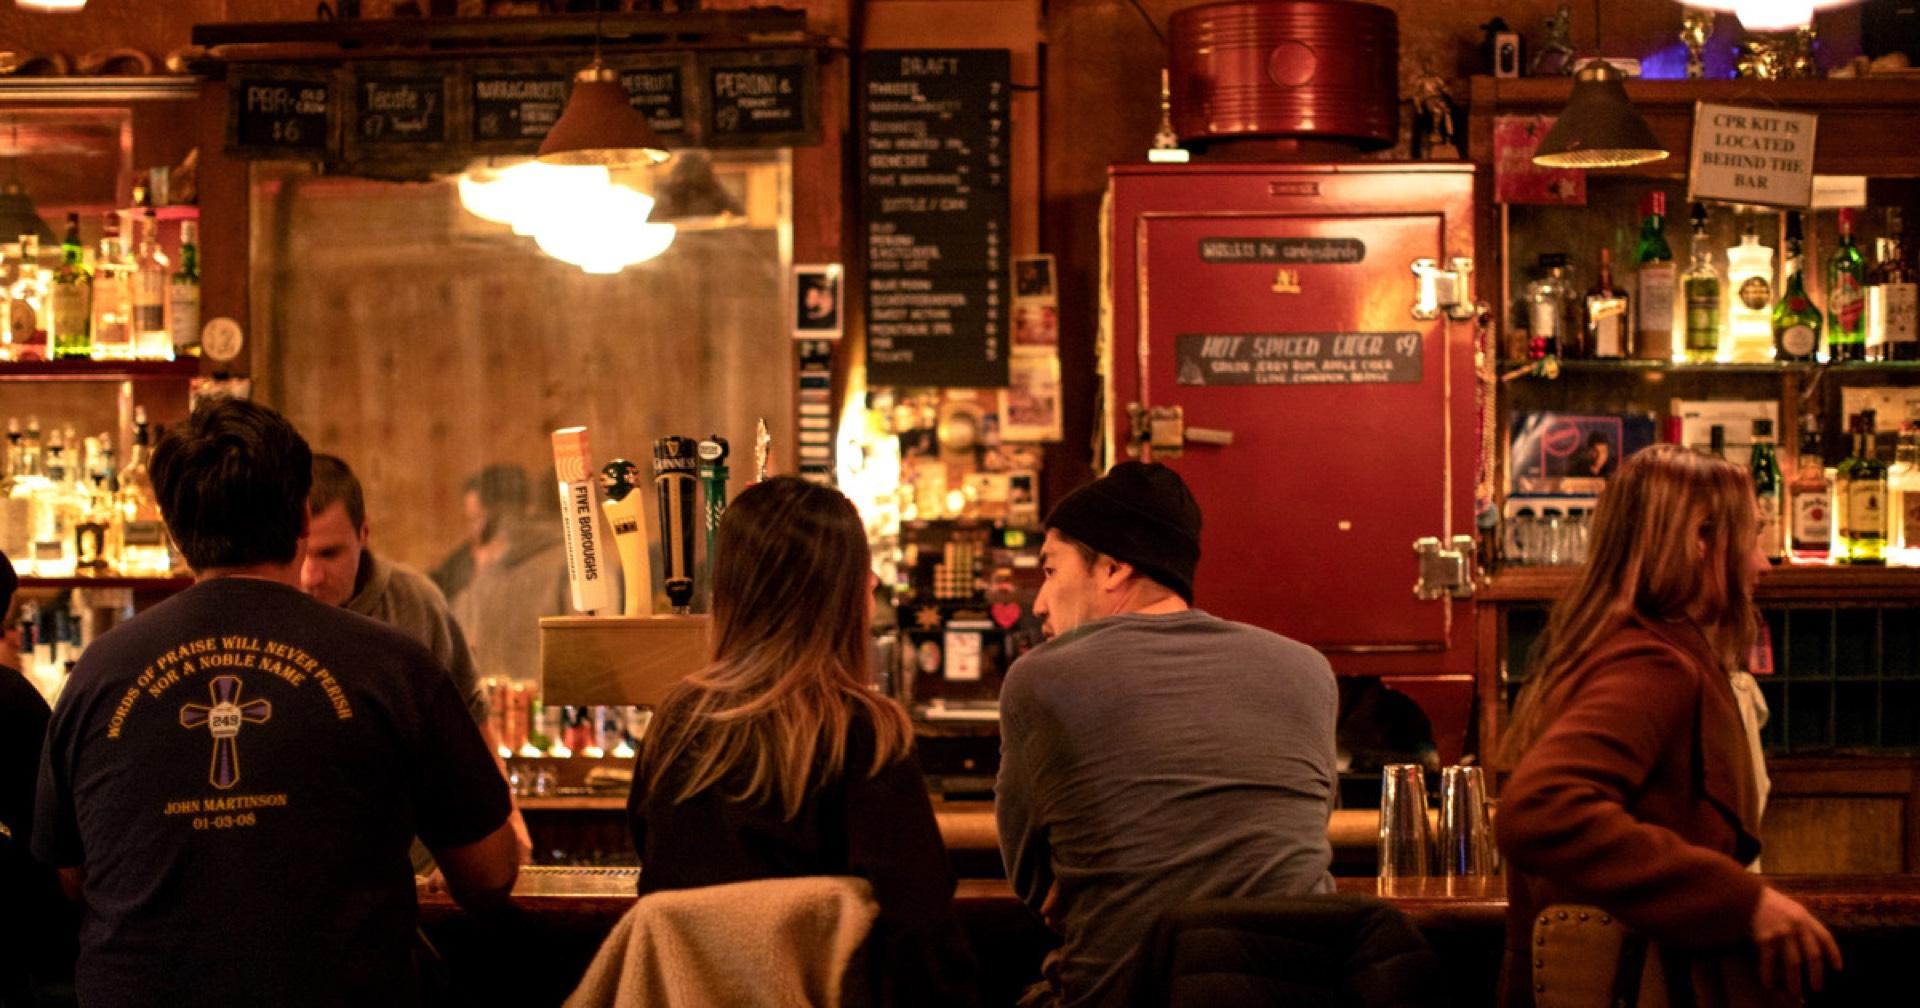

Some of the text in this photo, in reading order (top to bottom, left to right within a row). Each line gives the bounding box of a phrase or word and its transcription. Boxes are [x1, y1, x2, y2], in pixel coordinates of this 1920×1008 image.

[900, 57, 960, 76] DRAFT
[1713, 113, 1800, 134] CPR KIT IS
[1714, 133, 1796, 153] LOCATED
[1702, 152, 1804, 173] BEHIND THE
[1733, 174, 1769, 189] BAR
[1200, 334, 1246, 358] HOT
[1251, 334, 1320, 358] SPICED
[1332, 334, 1385, 358] CIDER
[654, 457, 697, 470] GUINNESS
[575, 485, 598, 581] FIVE BOROUGHS
[149, 653, 306, 699] NOR A NOBLE NAME
[107, 635, 353, 739] WORDS OF PRAISE WILL NEVER PERISH
[163, 794, 288, 815] JOHN MARTINSON
[192, 812, 257, 830] 01-03-08
